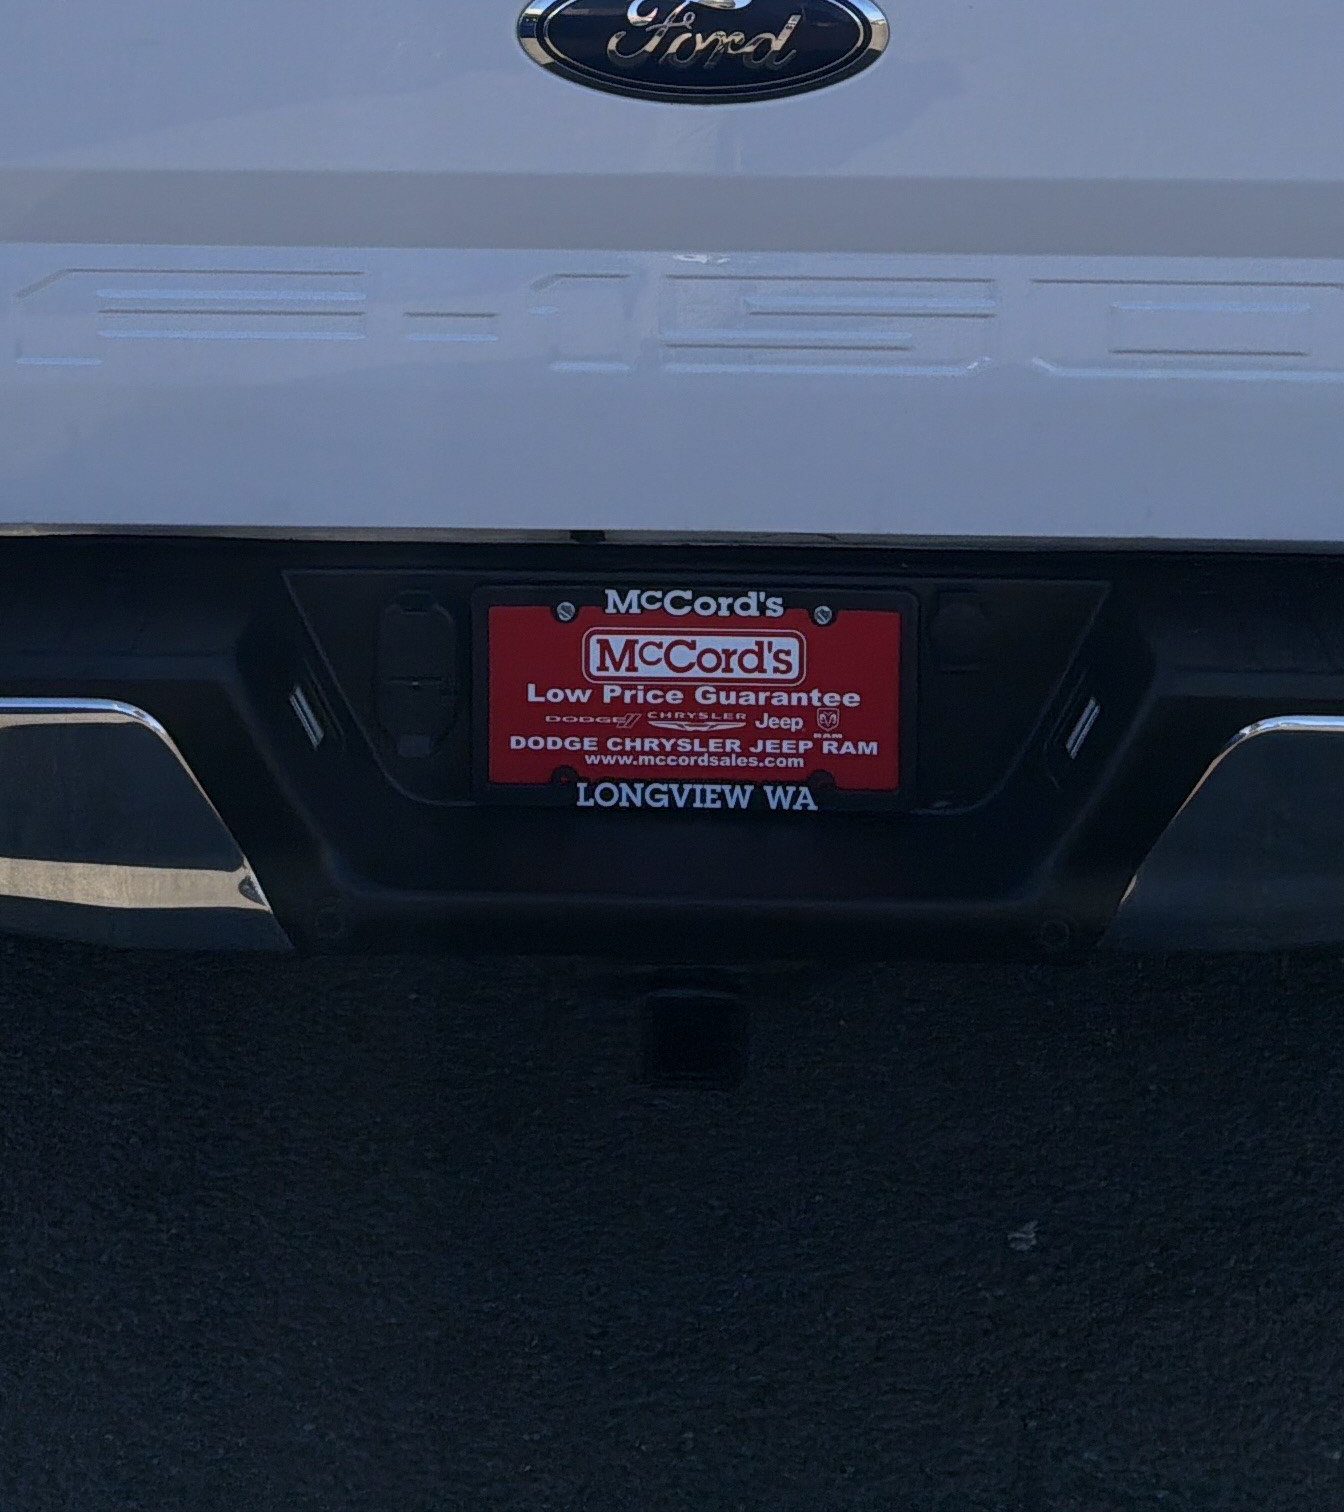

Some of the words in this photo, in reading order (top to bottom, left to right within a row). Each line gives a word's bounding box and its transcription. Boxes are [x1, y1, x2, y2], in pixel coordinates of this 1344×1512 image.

[604, 589, 785, 618] McCord's
[596, 638, 793, 675] McCord's
[527, 683, 592, 703] Low
[603, 684, 684, 704] Price
[694, 686, 861, 708] Guarantee
[545, 715, 627, 724] DODGE
[647, 711, 747, 720] CHRYSLER
[755, 712, 804, 731] Jeep
[510, 735, 599, 751] DODGE
[606, 738, 742, 753] CHRYSLER
[748, 740, 814, 754] JEEP
[822, 741, 879, 756] RAM
[584, 753, 805, 769] www.mccordsales.com
[576, 782, 755, 809] LONGVIEW
[762, 785, 819, 811] WA
